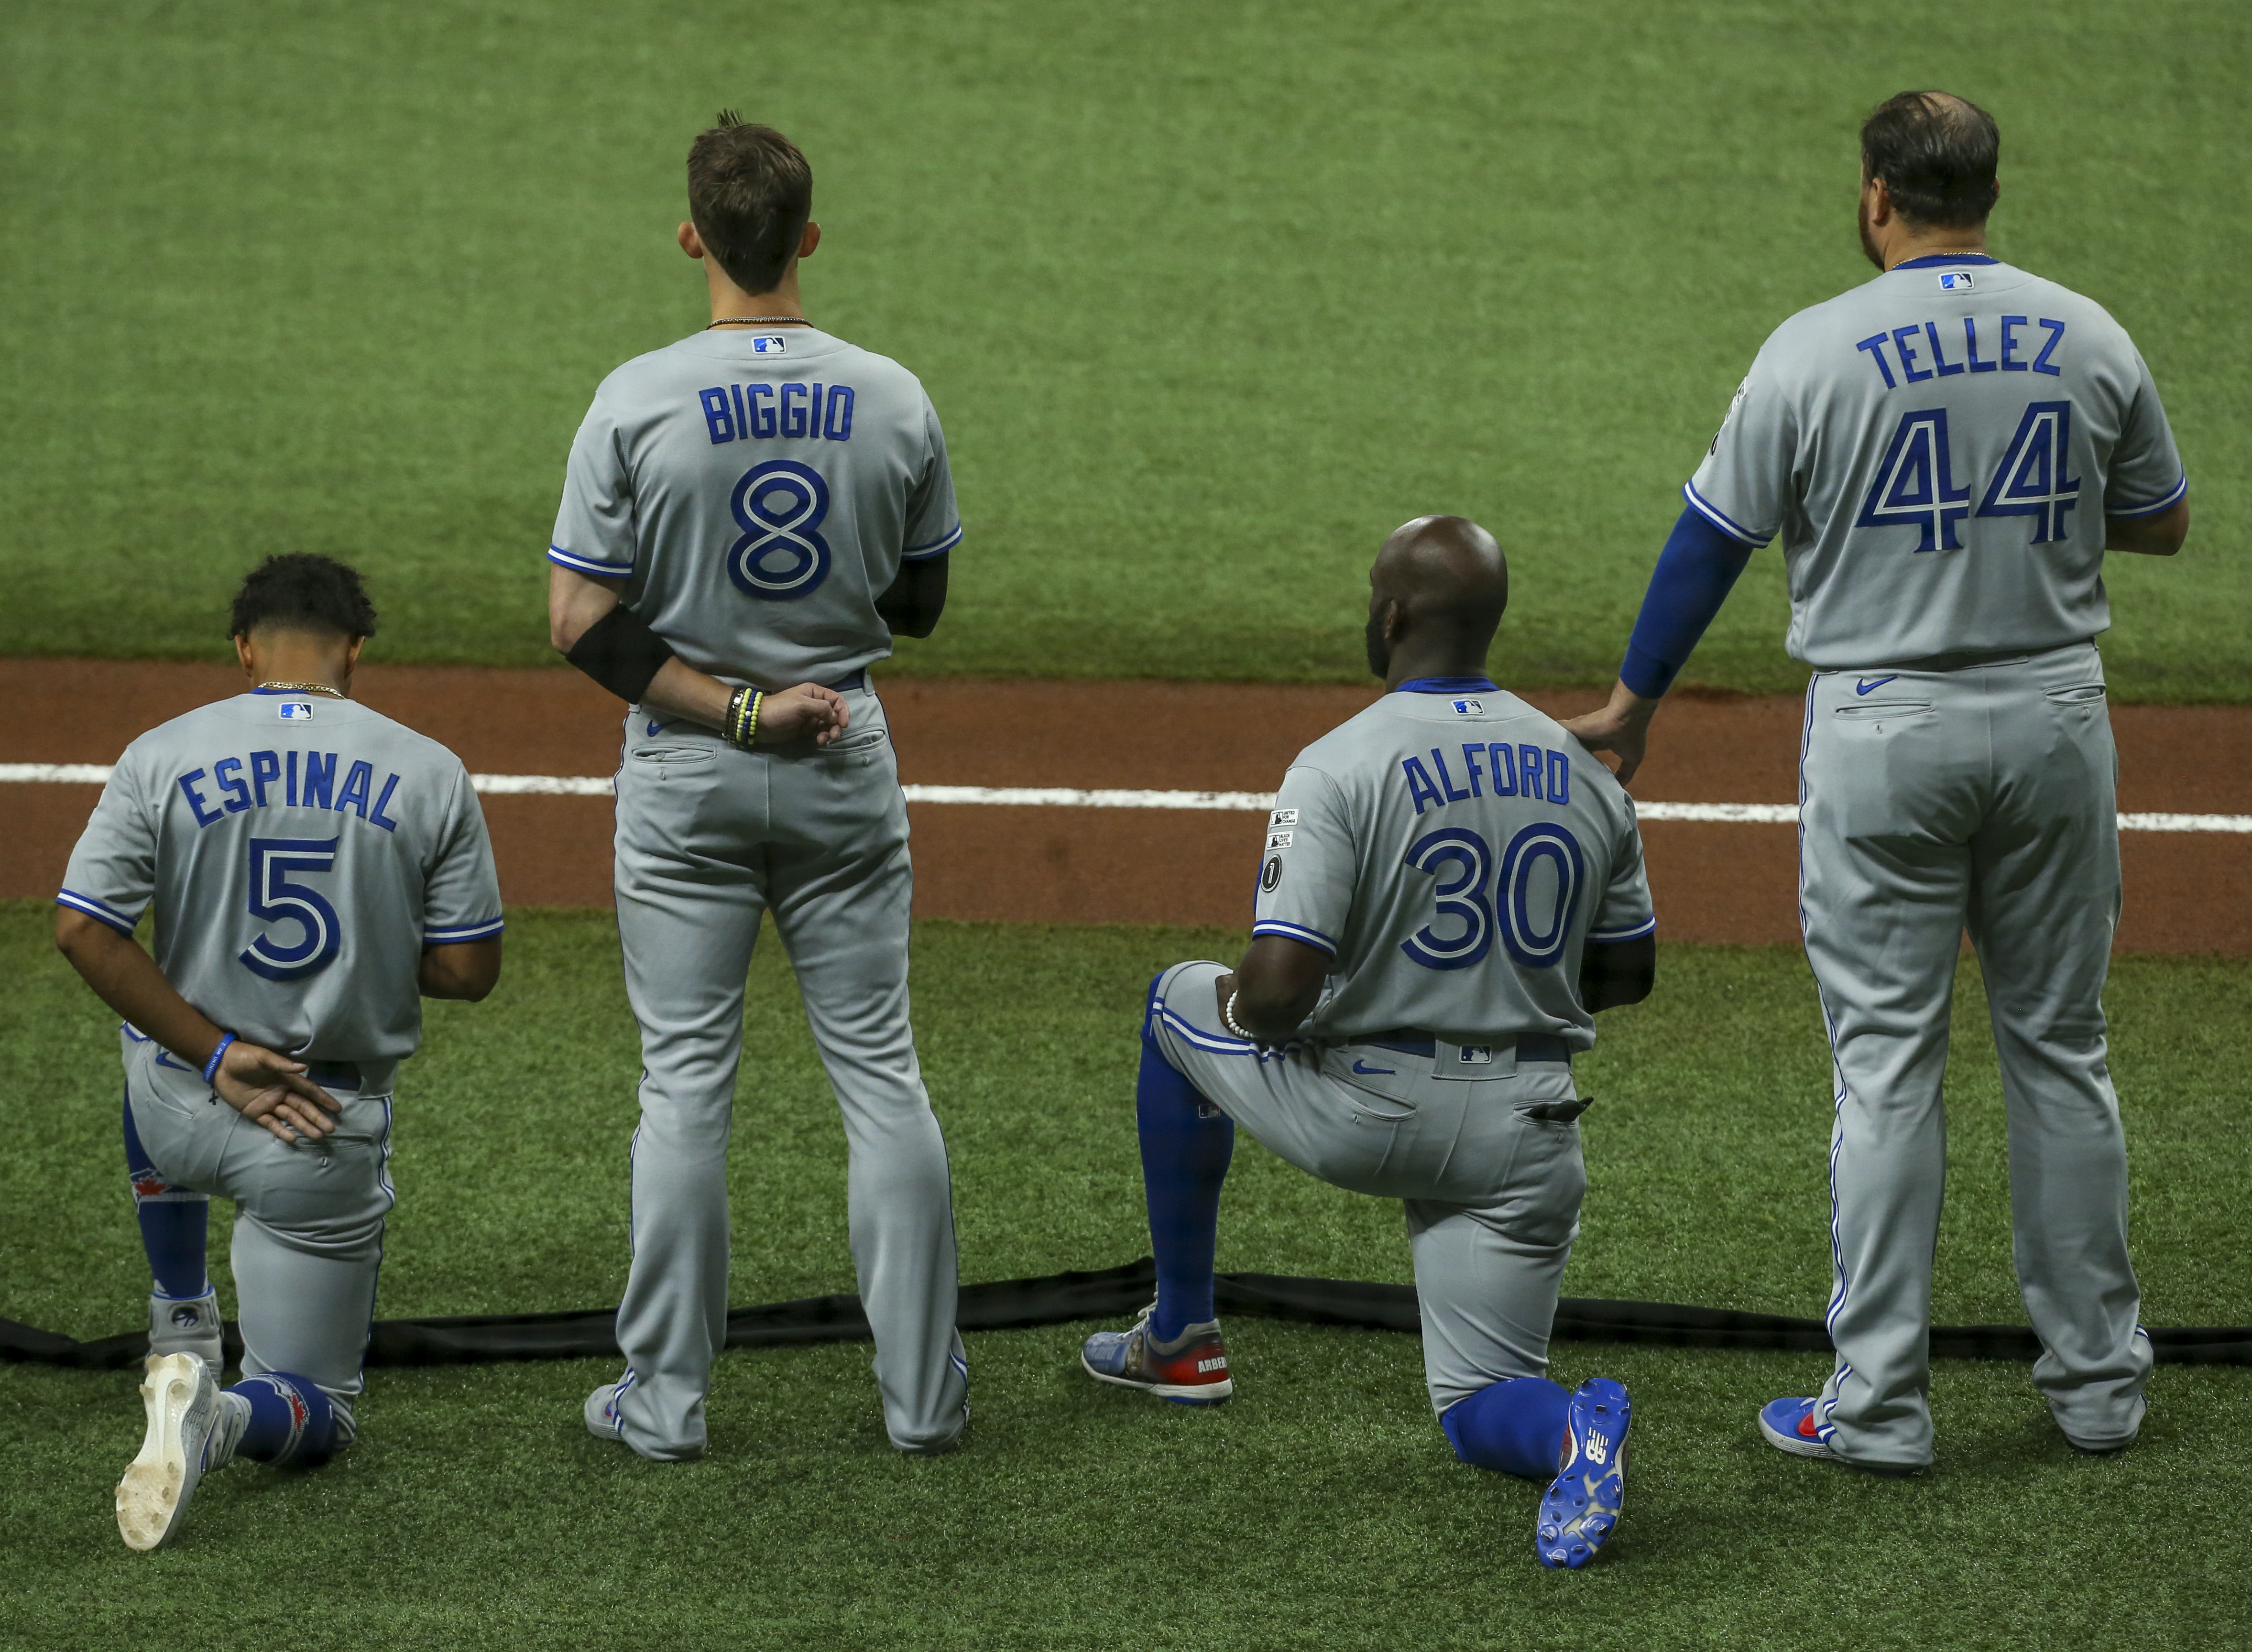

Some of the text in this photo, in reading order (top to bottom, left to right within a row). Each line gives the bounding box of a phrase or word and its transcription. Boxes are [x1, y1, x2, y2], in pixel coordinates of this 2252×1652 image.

[1856, 315, 2065, 389] TELLEZ
[699, 383, 855, 444] BIGGIO
[1856, 400, 2081, 553] 44
[727, 459, 831, 600] 8
[178, 750, 400, 831] ESPINAL
[1402, 742, 1569, 814] ALFORD
[238, 836, 340, 981] 5
[1268, 862, 1275, 884] 1
[1401, 822, 1584, 970] 30
